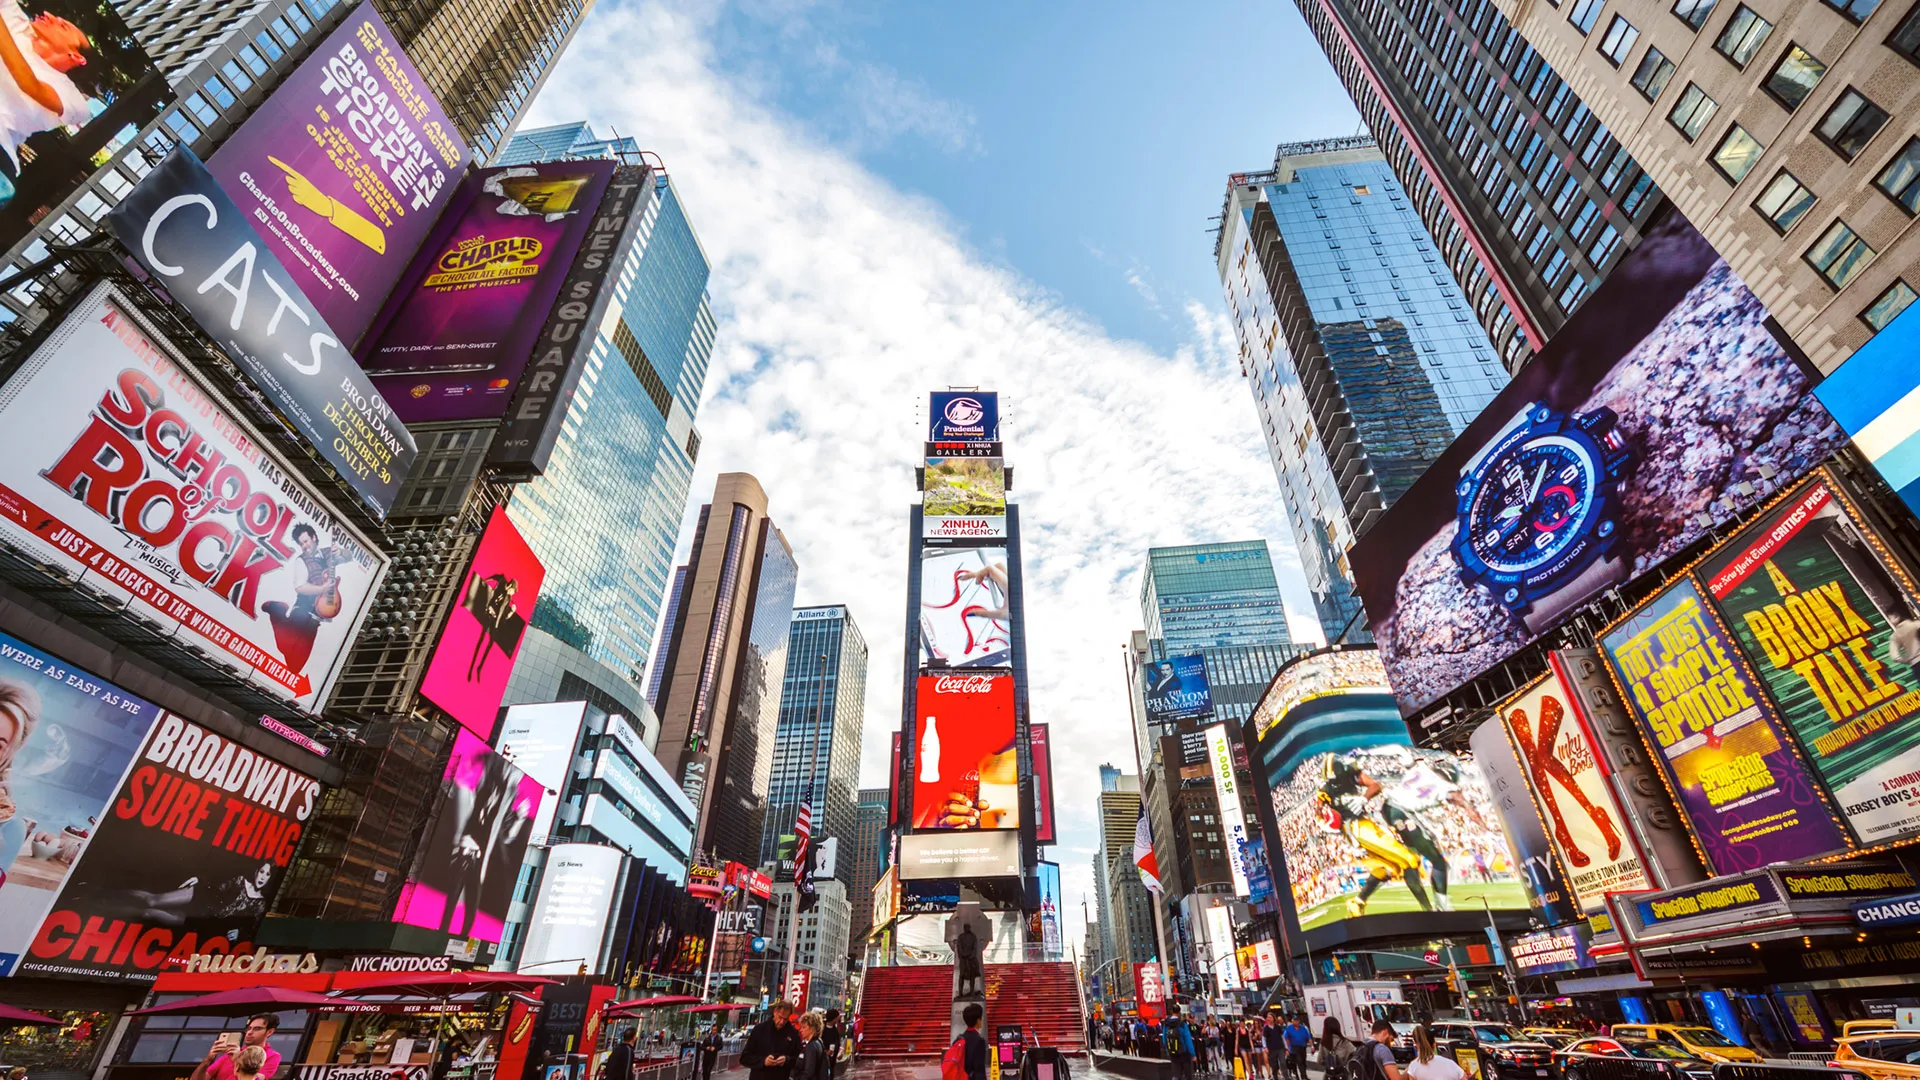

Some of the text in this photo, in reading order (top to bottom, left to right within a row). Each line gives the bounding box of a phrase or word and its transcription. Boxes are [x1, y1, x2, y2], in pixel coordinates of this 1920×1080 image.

[356, 26, 457, 170] THE CHOCOLATE FACTORY
[363, 21, 461, 162] CHARLIE AND
[329, 57, 438, 203] GOLDEN
[338, 43, 445, 189] BROADWAY'S
[320, 66, 431, 212] TICKET
[306, 123, 393, 228] ON STREET
[315, 104, 405, 217] IS JUST AROUND
[322, 126, 391, 212] THE CORNER
[240, 171, 360, 301] CharlieOnBroadway.com
[441, 238, 538, 269] CHARLIE
[141, 194, 339, 375] CATS
[440, 270, 495, 283] CHOCOLATE
[498, 266, 536, 276] FACTORY
[455, 283, 477, 291] NEW
[479, 278, 521, 288] MUSICAL
[516, 184, 638, 420] TIMES SQUARE
[381, 342, 497, 354] NUTTY, DARK SEMI-SWEET
[340, 376, 404, 457] BROADWAY
[371, 394, 391, 421] ON
[168, 371, 335, 533] LLOYD WEBBER HAS BROADWAY
[322, 402, 391, 484] DECEMBER 30
[340, 398, 392, 465] THROUGH
[504, 439, 529, 447] NYC
[98, 367, 297, 560] SCHOOL
[333, 437, 368, 481] ONLY!
[1475, 428, 1529, 480] G-SHOCK
[1560, 464, 1579, 485] 3
[1501, 464, 1522, 489] 12
[38, 411, 284, 620] ROCK
[941, 520, 989, 528] XINHUA
[134, 540, 150, 552] THE
[1210, 551, 1262, 561] BARCLAYS
[1506, 527, 1529, 551] SAT
[1709, 486, 1829, 594] The New York Times CRITICS' PICK
[139, 551, 181, 579] MUSICAL
[1527, 541, 1587, 586] PROTECTION
[1763, 559, 1797, 597] A
[50, 528, 299, 688] JUST 4 BLOCKS TO THE WINTER GARDEN THEATRE
[796, 611, 825, 619] Allianz
[1743, 580, 1873, 669] BRONX
[1618, 606, 1711, 686] NOT JUST
[0, 644, 141, 715] WERE AS EASY AS PIE
[935, 676, 994, 693] Coca-Cola
[1632, 635, 1732, 713] A SIMPLE
[1791, 638, 1901, 723] TALE
[1146, 690, 1209, 709] PHANTOM
[1179, 700, 1205, 708] OPERA
[1647, 666, 1756, 748] SPONGE
[1578, 658, 1671, 829] PALACE
[1813, 701, 1899, 757] BROADWAY'S NEW HIT
[145, 717, 320, 822] BROADWAY'S
[1569, 752, 1594, 776] Boots
[1697, 752, 1767, 793] SPONGEBOB
[1707, 770, 1775, 806] SQUAREPANTS
[1846, 799, 1884, 817] JERSEY
[1884, 790, 1912, 806] BOYS
[115, 765, 300, 868] SURE THING
[1572, 870, 1596, 886] WINNER!
[1600, 864, 1618, 878] TONY
[1577, 882, 1602, 893] INCLUDING
[1602, 878, 1618, 887] BEST
[1848, 872, 1916, 890] SQUAREPANTS
[1698, 883, 1760, 913] SQUAREPANTS
[186, 947, 319, 974] nuchas
[1533, 940, 1554, 952] CENTER
[1563, 935, 1576, 947] THE
[1540, 949, 1577, 965] FESTIVITIES!
[23, 962, 120, 978] CHICAGOTHEMUSICAL.COM
[351, 957, 450, 972] NYC HOTDOGS
[1141, 966, 1157, 1002] tkts
[549, 1003, 584, 1020] BEST
